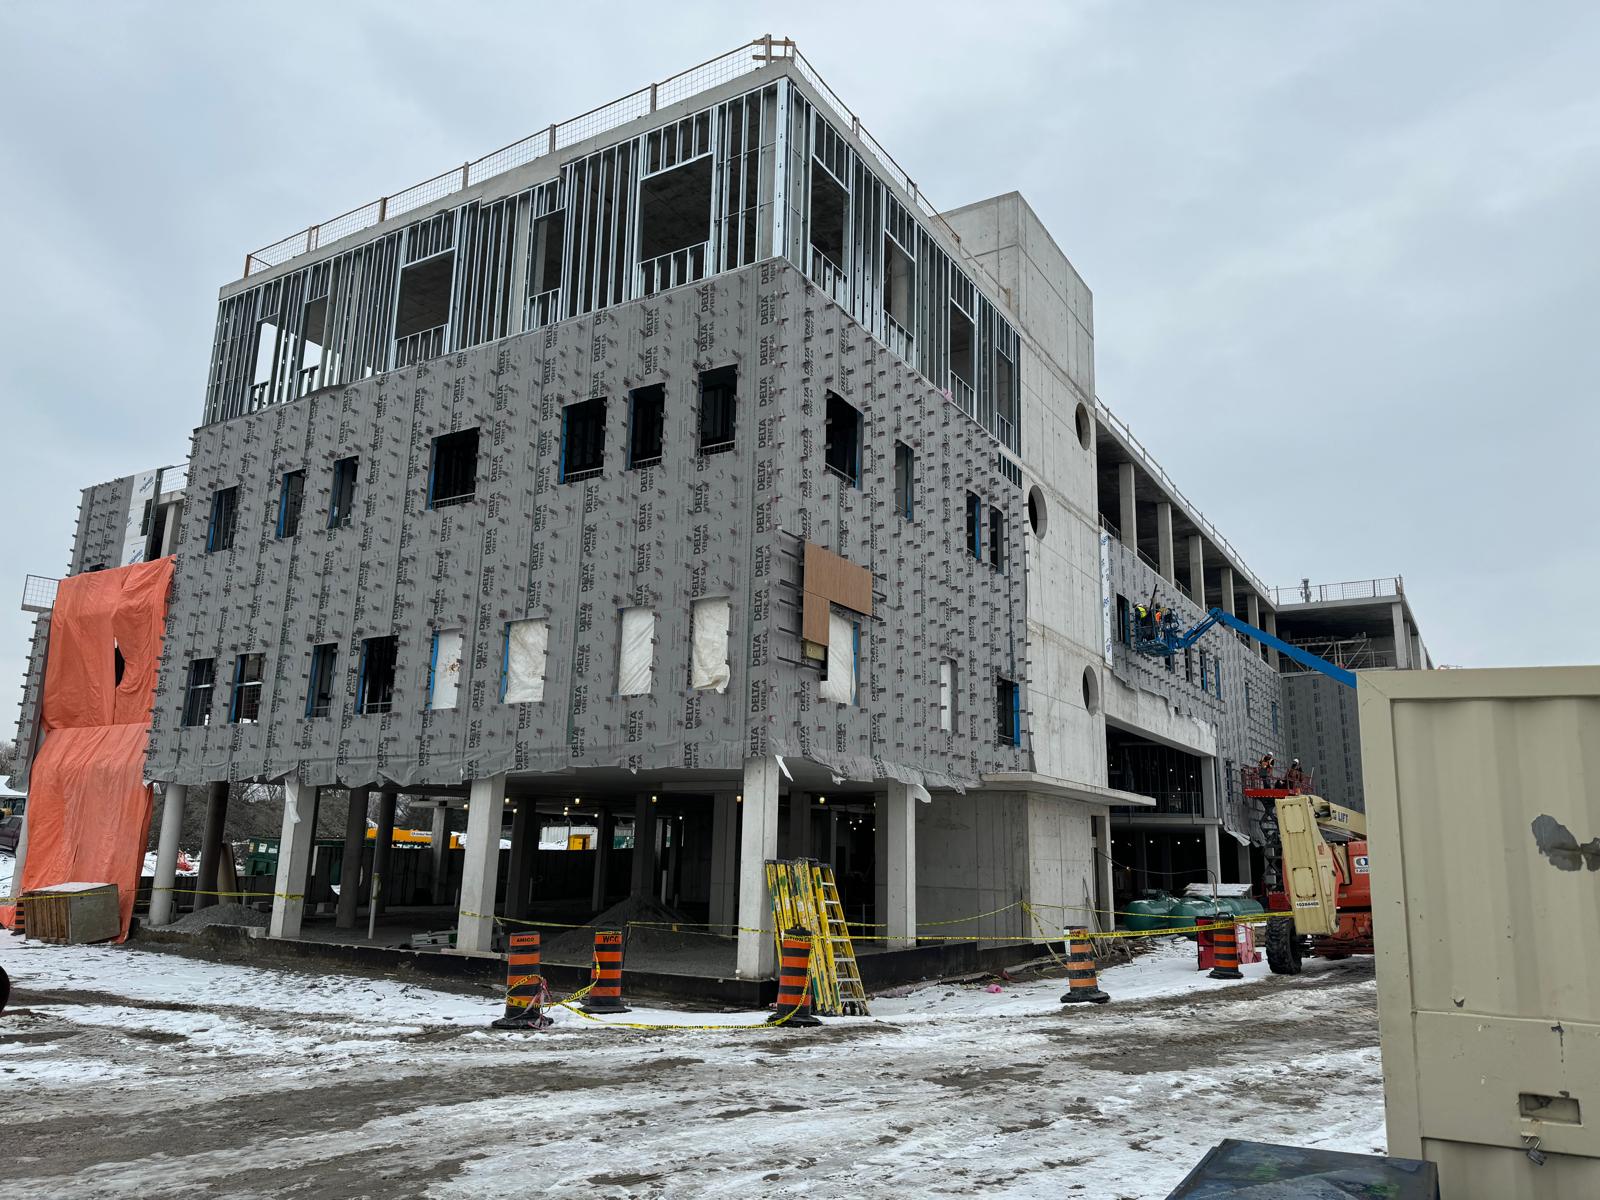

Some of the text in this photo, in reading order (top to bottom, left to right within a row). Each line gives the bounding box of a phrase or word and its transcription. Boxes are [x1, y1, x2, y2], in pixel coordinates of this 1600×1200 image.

[701, 284, 709, 312] DELTA
[761, 295, 769, 325] DELTA
[546, 324, 554, 348] DELTA
[646, 309, 654, 338] DELTA
[700, 324, 708, 352] DELTA
[760, 336, 768, 366] DELTA
[453, 378, 461, 403] DELTA
[496, 385, 504, 411] DELTA
[759, 377, 767, 407] DELTA
[338, 421, 346, 444] DELTA
[540, 431, 548, 457] DELTA
[758, 419, 766, 448] DELTA
[369, 460, 377, 484] DELTA
[407, 455, 415, 479] DELTA
[491, 456, 499, 482] DELTA
[537, 467, 545, 495] DELTA
[757, 460, 766, 491] DELTA
[488, 493, 496, 518] DELTA
[586, 486, 594, 513] DELTA
[695, 484, 703, 513] DELTA
[440, 517, 448, 542] DELTA
[534, 505, 542, 532] DELTA
[639, 503, 647, 532] DELTA
[756, 503, 765, 533] DELTA
[485, 529, 493, 555] DELTA
[584, 524, 592, 552] DELTA
[693, 525, 701, 555] DELTA
[637, 543, 645, 573] DELTA
[755, 546, 764, 577] DELTA
[581, 564, 589, 592] DELTA
[692, 568, 700, 597] DELTA
[528, 582, 537, 609] DELTA
[636, 585, 644, 606] ELTA
[754, 590, 763, 621] DELTA
[576, 645, 585, 674] DELTA
[752, 635, 761, 667] DELTA
[472, 681, 481, 708] DELTA
[574, 685, 582, 715] DELTA
[751, 680, 760, 712] DELTA
[628, 711, 637, 743] DELTA
[685, 697, 694, 730] DELTA
[469, 720, 477, 748] DELTA
[750, 727, 759, 758] DELTA
